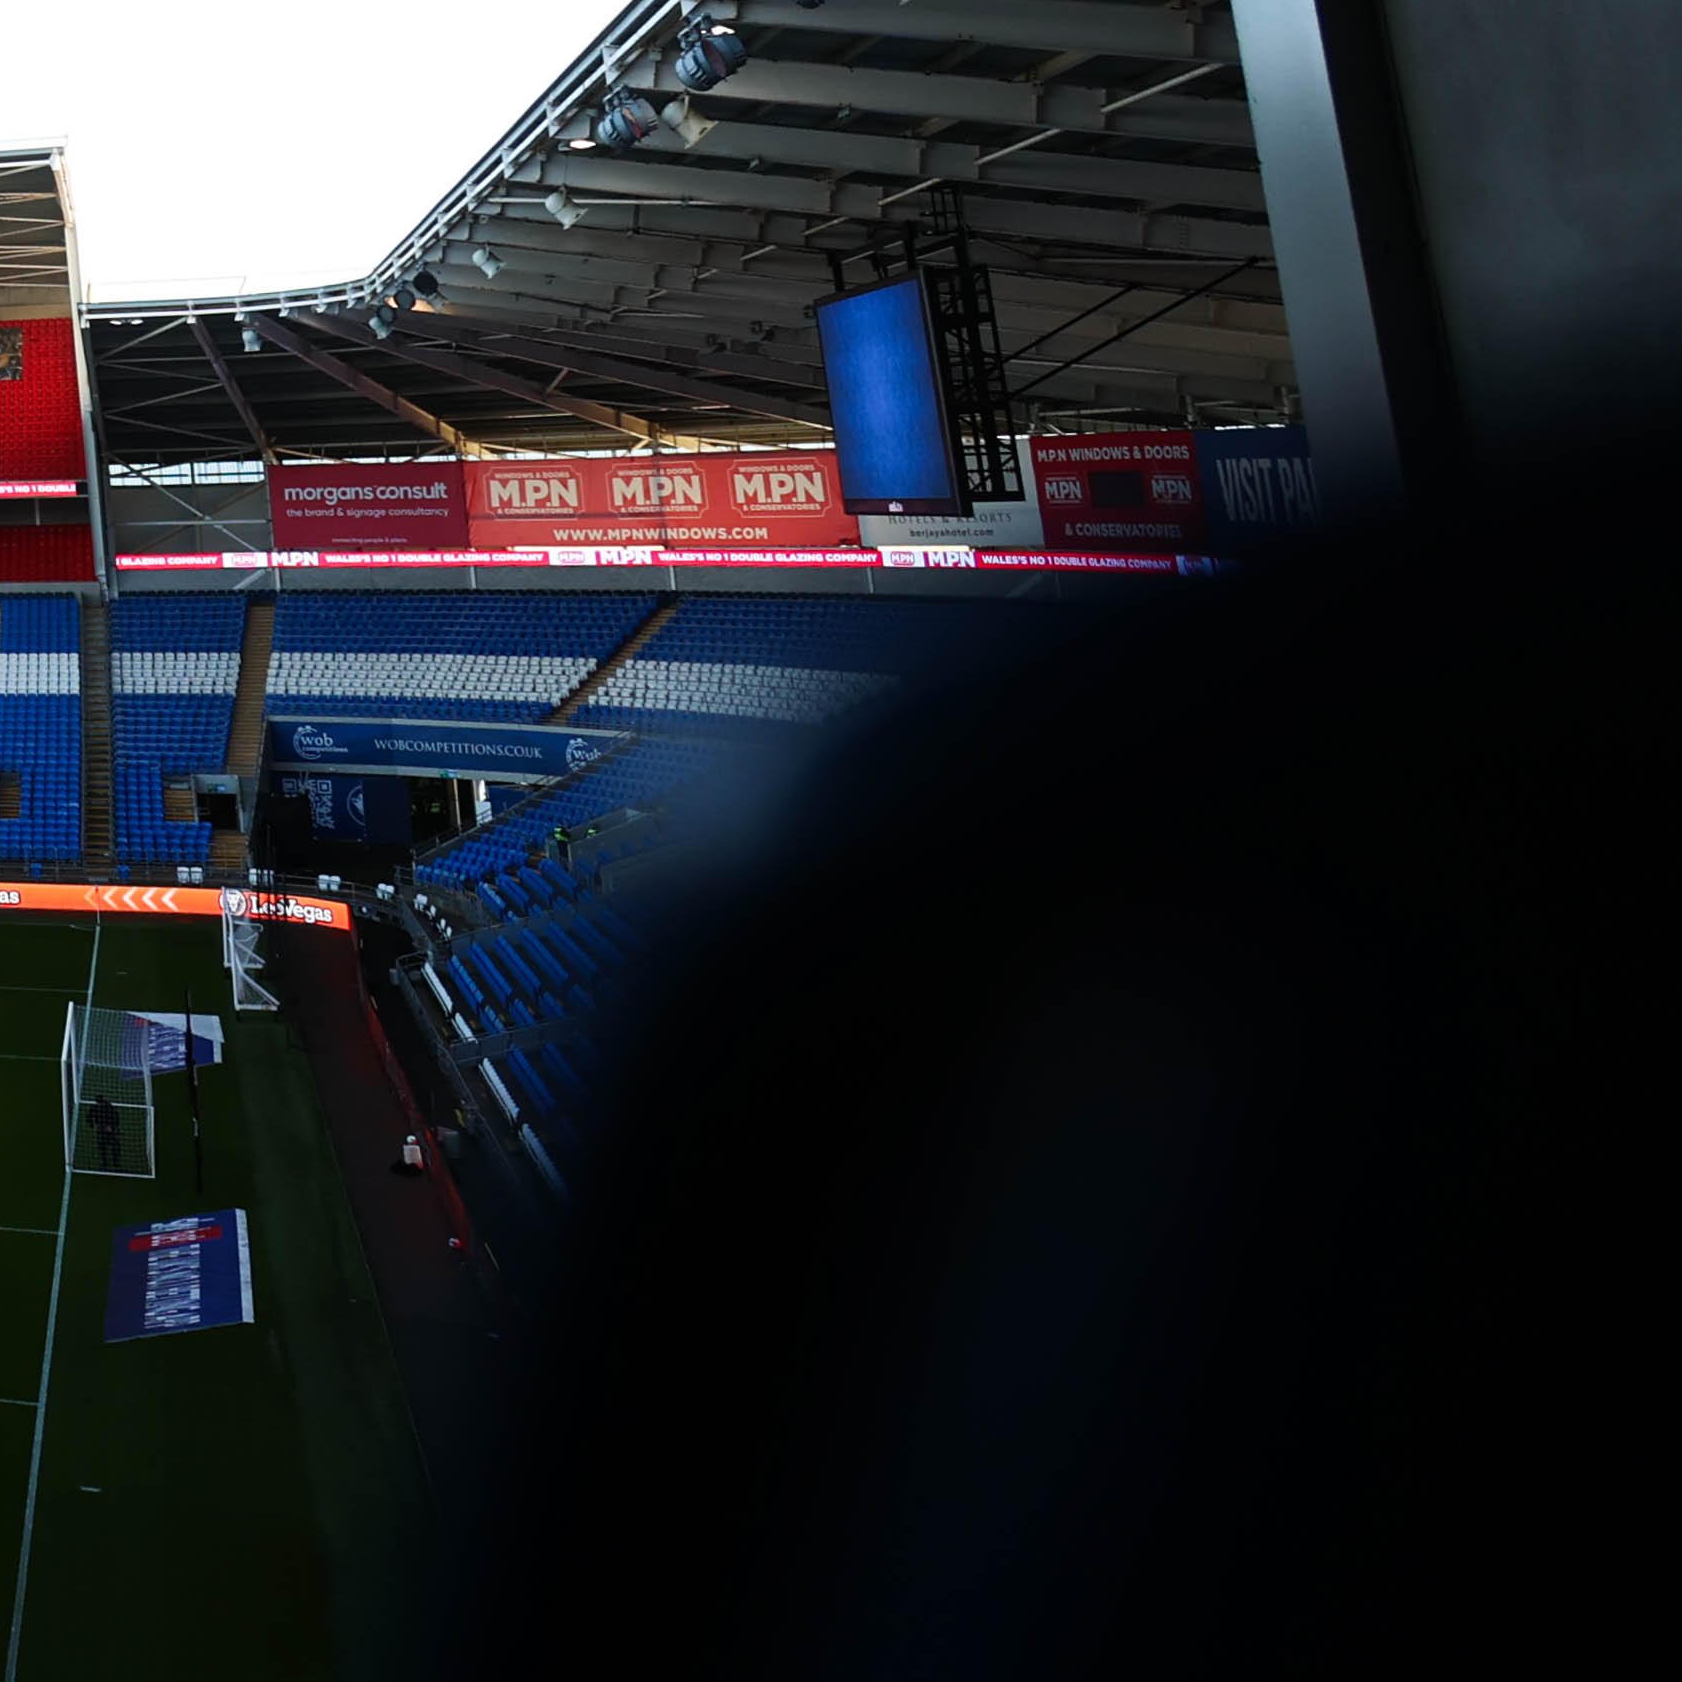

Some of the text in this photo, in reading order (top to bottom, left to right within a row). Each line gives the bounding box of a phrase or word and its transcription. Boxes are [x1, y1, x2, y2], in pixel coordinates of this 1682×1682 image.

[1068, 446, 1130, 461] WINDOWS
[1133, 445, 1141, 459] &
[1143, 445, 1190, 459] DOORS
[489, 479, 579, 508] M.P.N
[612, 475, 703, 506] M.P.N
[733, 472, 826, 504] M.P.N
[1215, 458, 1276, 525] VISIT
[286, 507, 449, 518] the brand & signage consultancy
[553, 527, 768, 541] WWW.MPNWINDOWS.COM
[909, 528, 994, 538] berjayahotel.com
[1064, 524, 1074, 536] &
[325, 554, 371, 563] WALES'S
[492, 553, 544, 562] COMPANY
[658, 553, 704, 562] WALES'S
[825, 553, 877, 562] COMPANY
[982, 555, 1027, 566] WALES'S
[1054, 557, 1087, 567] DOUBLE
[1088, 557, 1126, 568] GLAZING
[301, 732, 334, 747] wob
[374, 738, 543, 759] WOBCOMPETITIONS.CO.UK
[249, 895, 333, 924] LeoVegas
